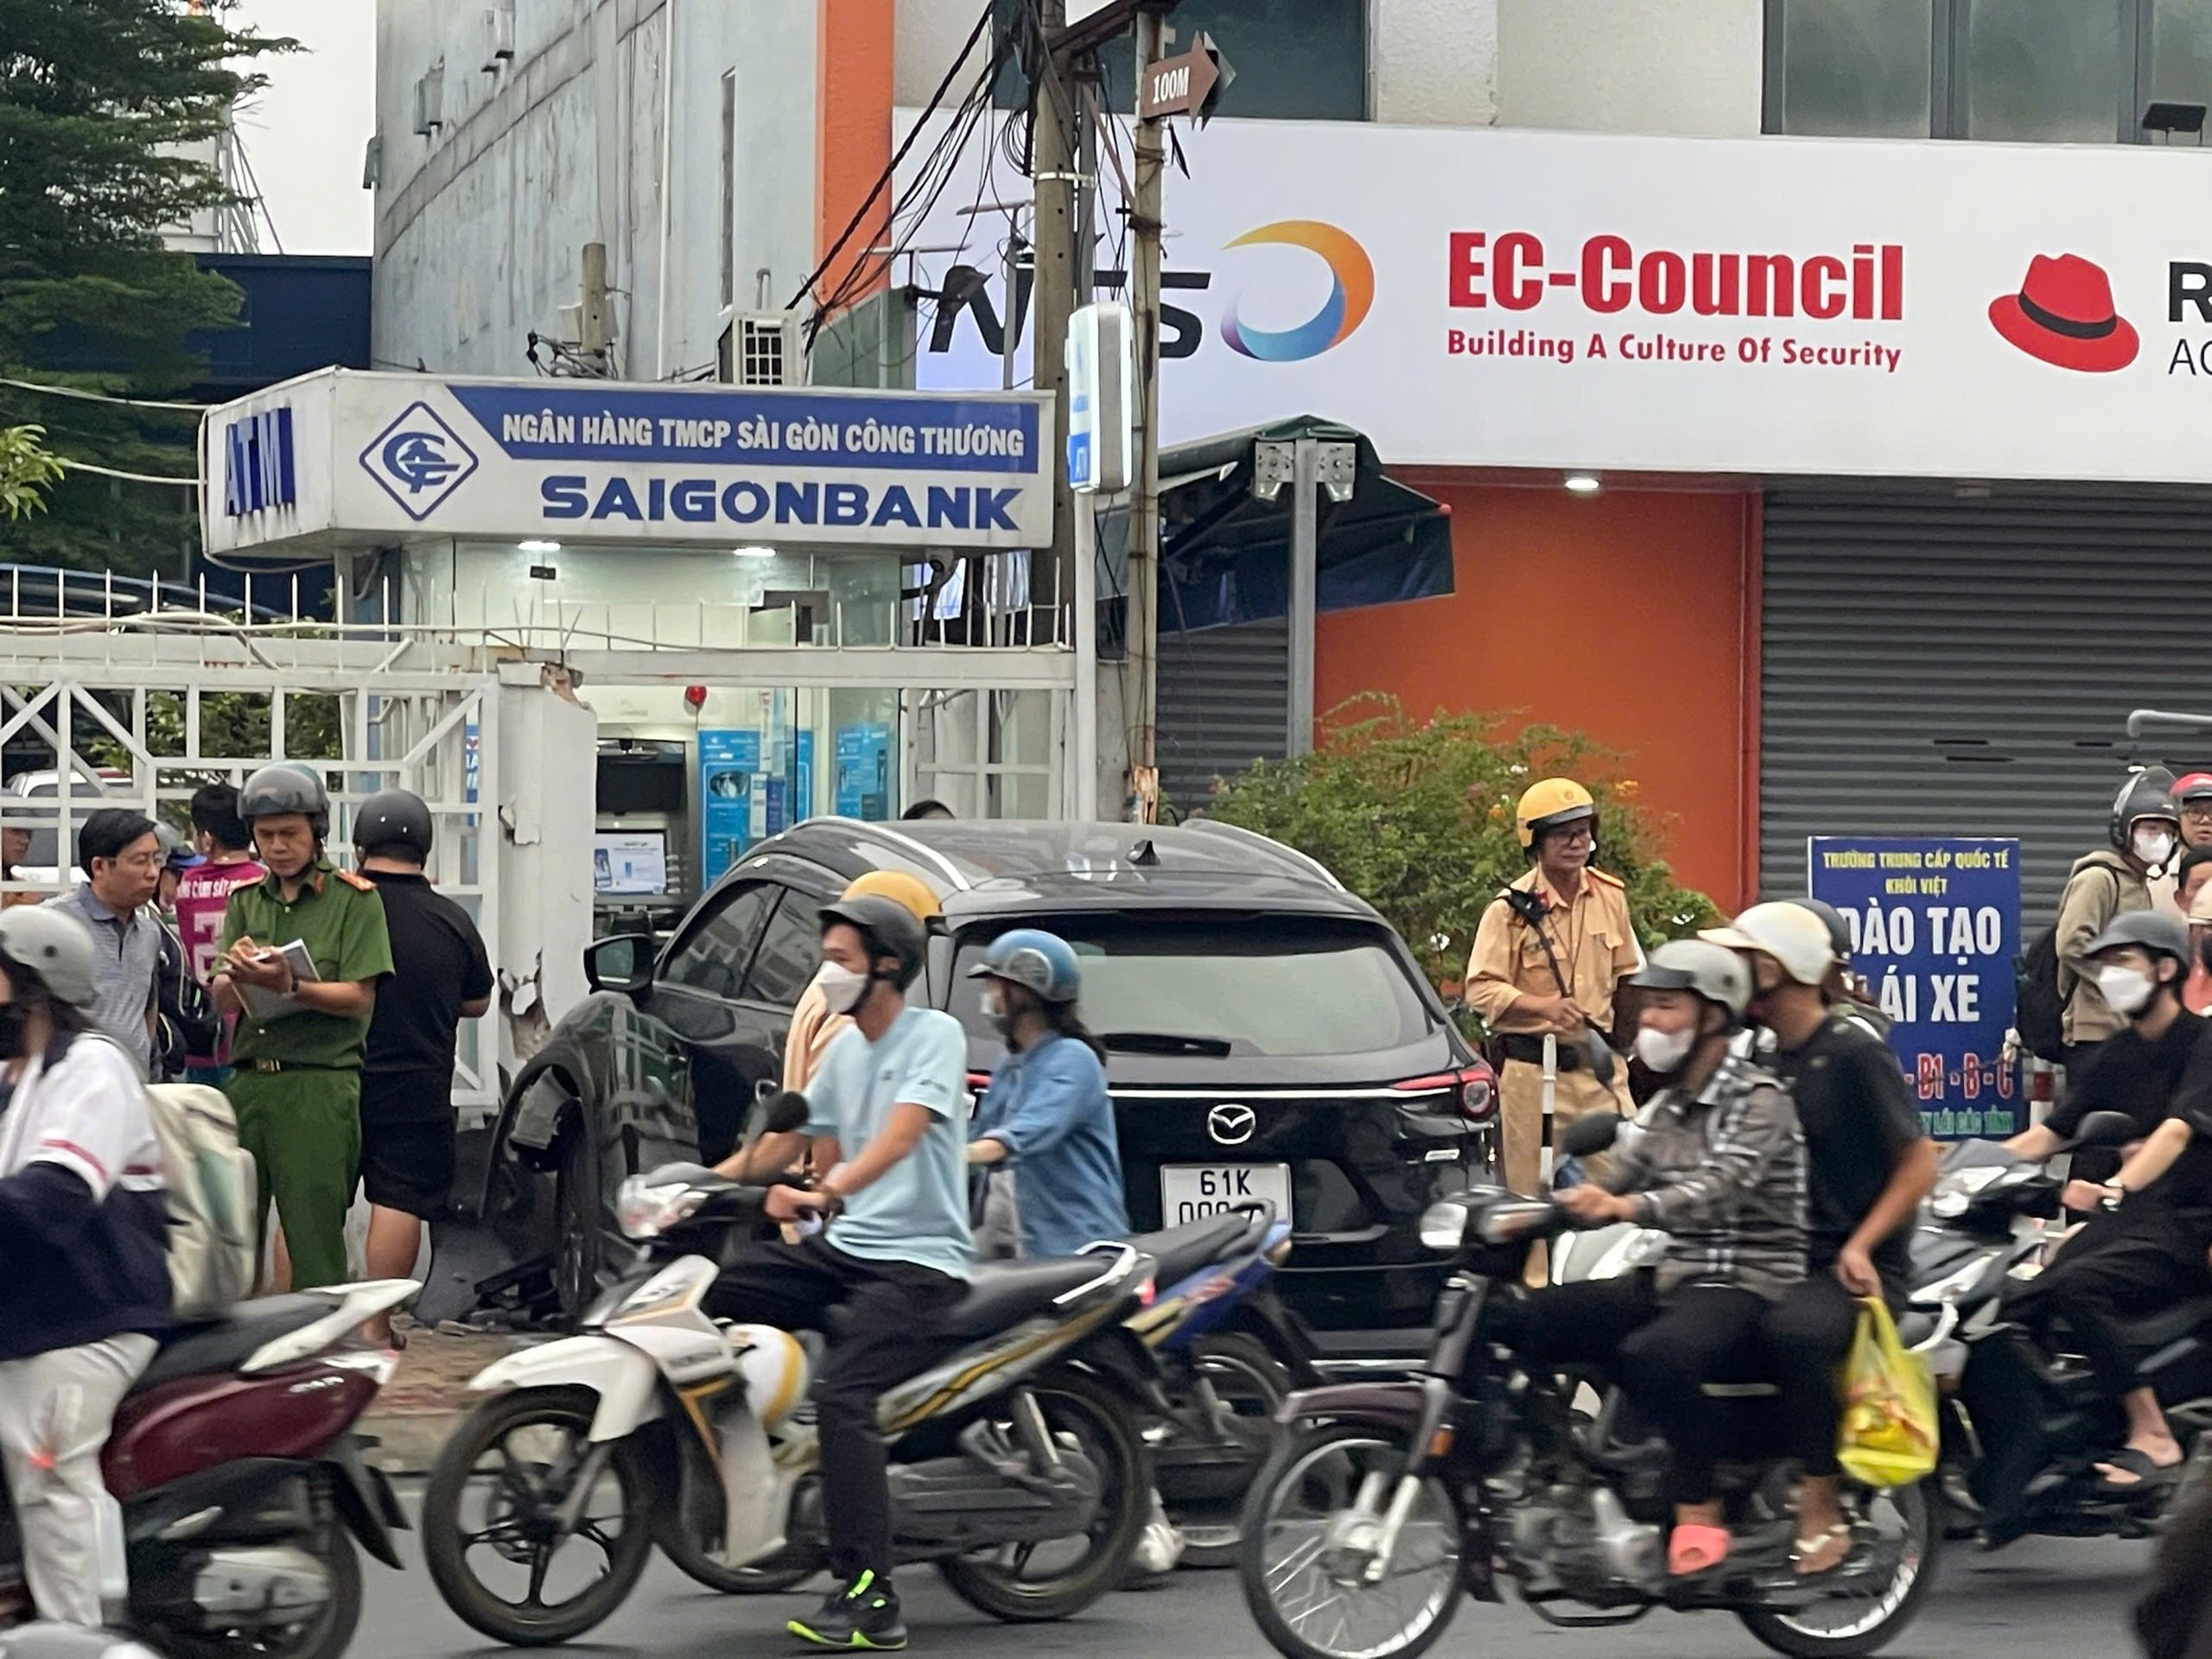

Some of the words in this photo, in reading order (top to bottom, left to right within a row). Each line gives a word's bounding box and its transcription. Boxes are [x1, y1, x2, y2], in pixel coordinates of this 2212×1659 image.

[1152, 66, 1190, 105] 100M
[1448, 231, 1904, 321] EC-Council
[1447, 329, 1574, 364] Building
[1586, 334, 1608, 359] A
[1618, 334, 1726, 362] Culture
[1738, 336, 1771, 363] Of
[1783, 339, 1902, 372] Security
[503, 408, 576, 444] NGÂN
[582, 410, 652, 447] HÀNG
[659, 418, 732, 449] TMCP
[737, 414, 779, 450] SÀI
[785, 415, 838, 452] GÒN
[847, 417, 915, 454] CÔNG
[920, 423, 1025, 458] THƯƠNG
[226, 408, 295, 517] ATM
[541, 474, 1023, 531] SAIGONBANK
[1878, 851, 1923, 869] TRUNG
[1924, 847, 1952, 869] CẤP
[1955, 847, 1991, 870] QUỐC
[1993, 847, 2010, 869] TẾ
[1920, 874, 1948, 899] VIỆT
[1926, 906, 2001, 966] TẠO
[1857, 964, 1917, 1023] ÁI
[1929, 974, 1980, 1023] XE
[1199, 1169, 1252, 1197] 61K
